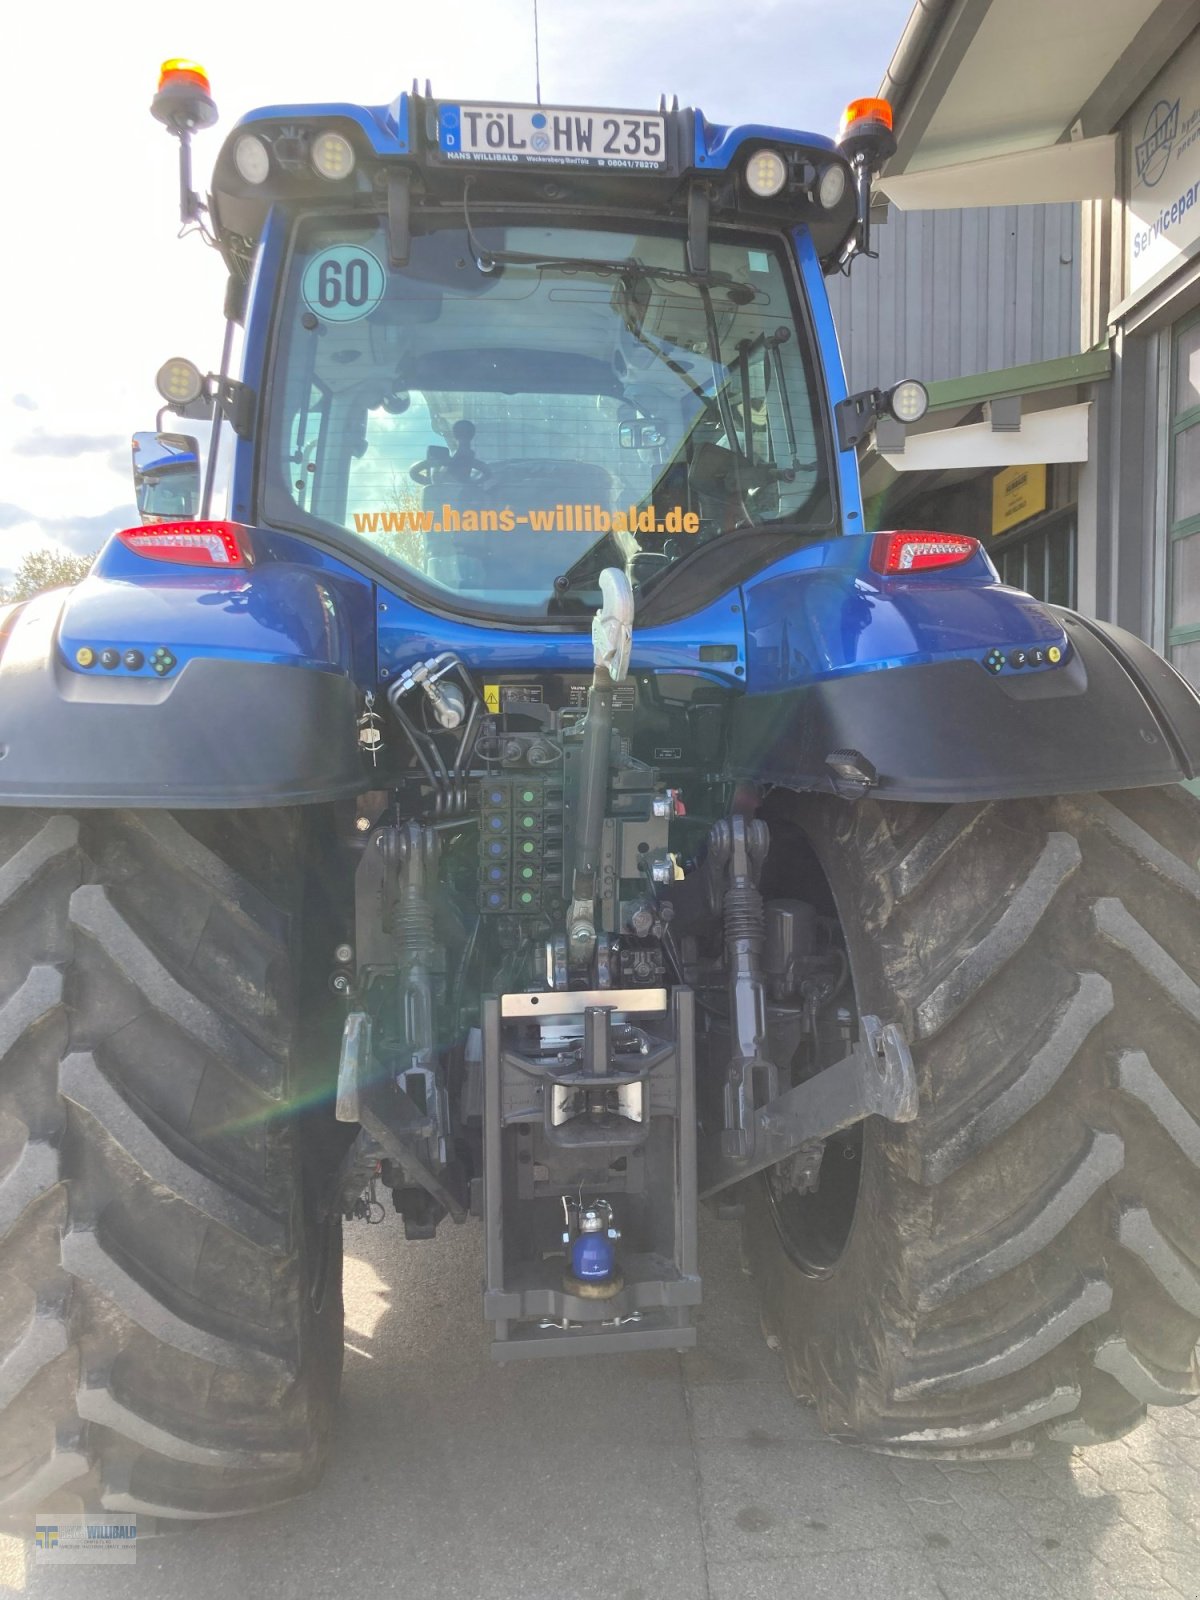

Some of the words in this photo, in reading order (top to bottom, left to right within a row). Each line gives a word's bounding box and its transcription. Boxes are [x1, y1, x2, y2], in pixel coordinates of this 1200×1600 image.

[446, 134, 455, 146] D
[463, 111, 527, 149] TÖL
[553, 115, 593, 153] HW
[603, 118, 661, 156] 235
[447, 151, 471, 160] HANS
[473, 153, 519, 162] WILLIBALD
[319, 258, 369, 308] 60
[353, 503, 700, 533] www.hans-willibald.de
